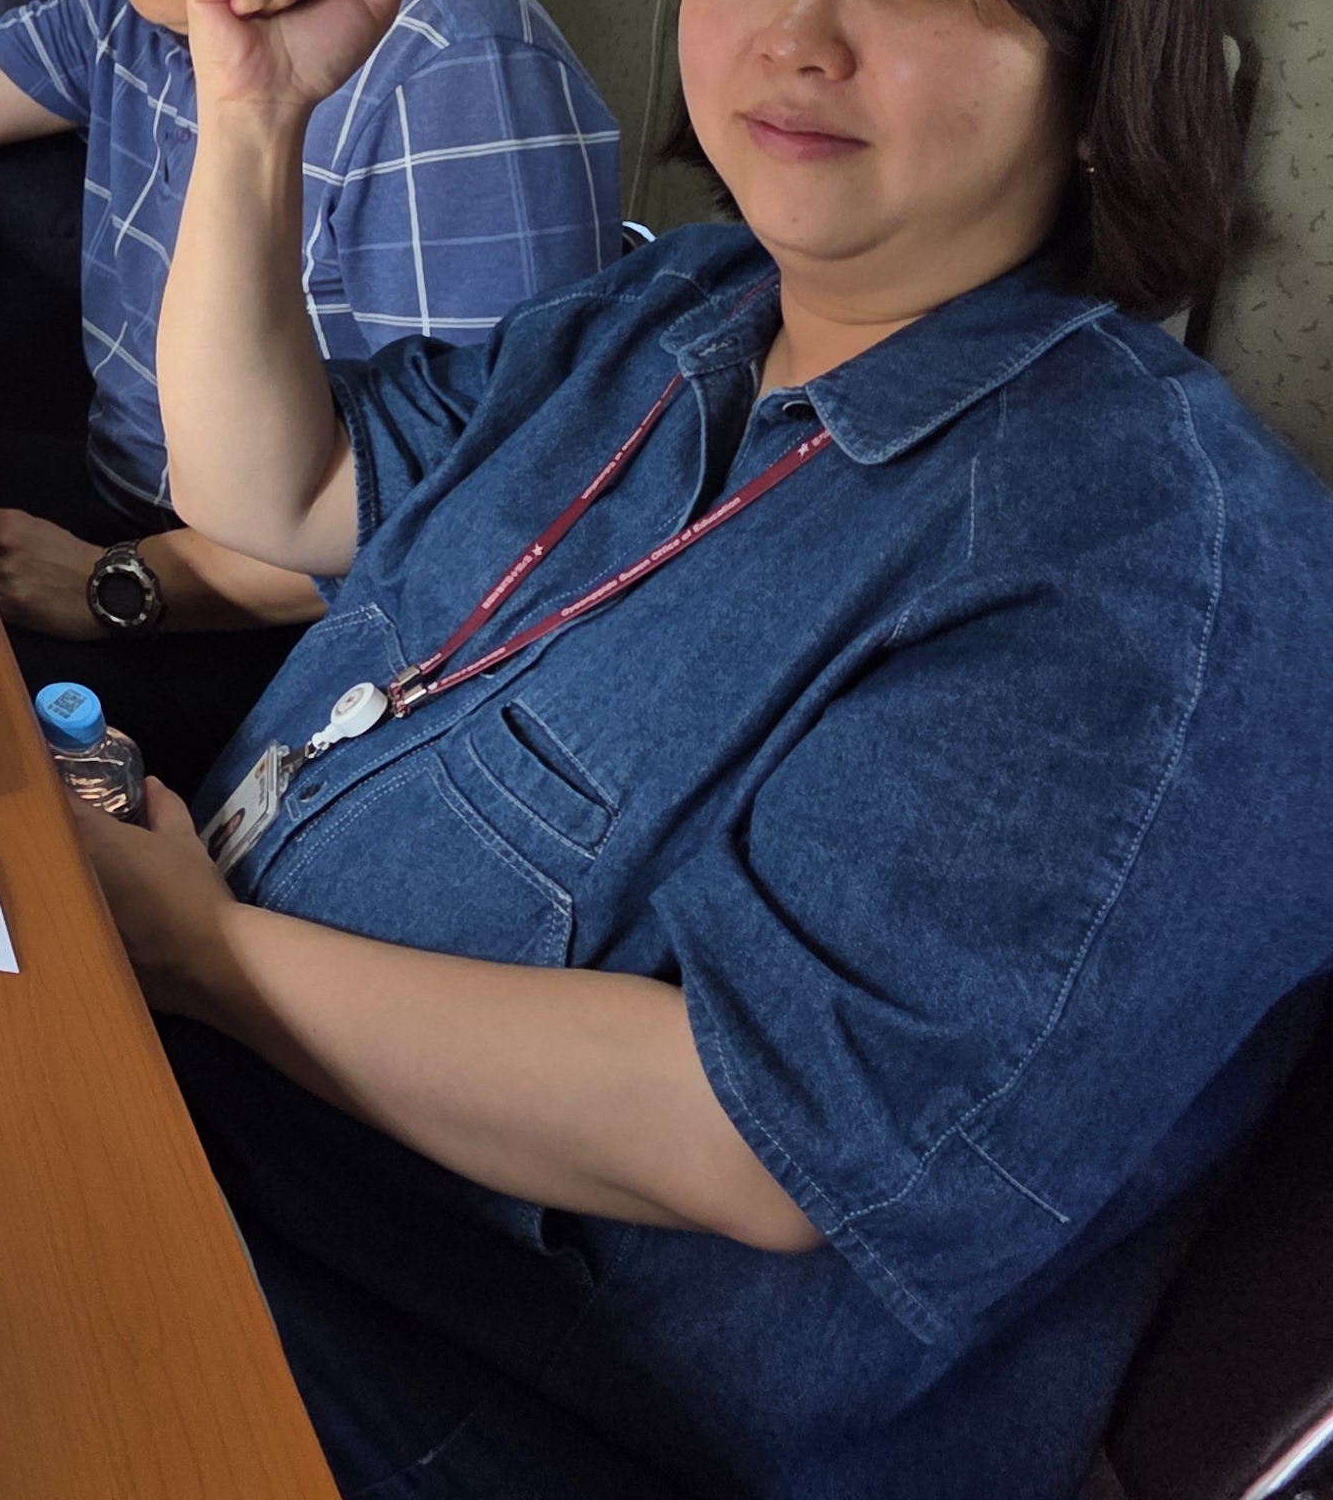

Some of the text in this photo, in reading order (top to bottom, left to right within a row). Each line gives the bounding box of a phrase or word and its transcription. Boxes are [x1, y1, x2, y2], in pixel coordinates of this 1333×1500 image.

[651, 538, 681, 562] Office
[681, 528, 693, 542] of
[692, 496, 742, 534] Education
